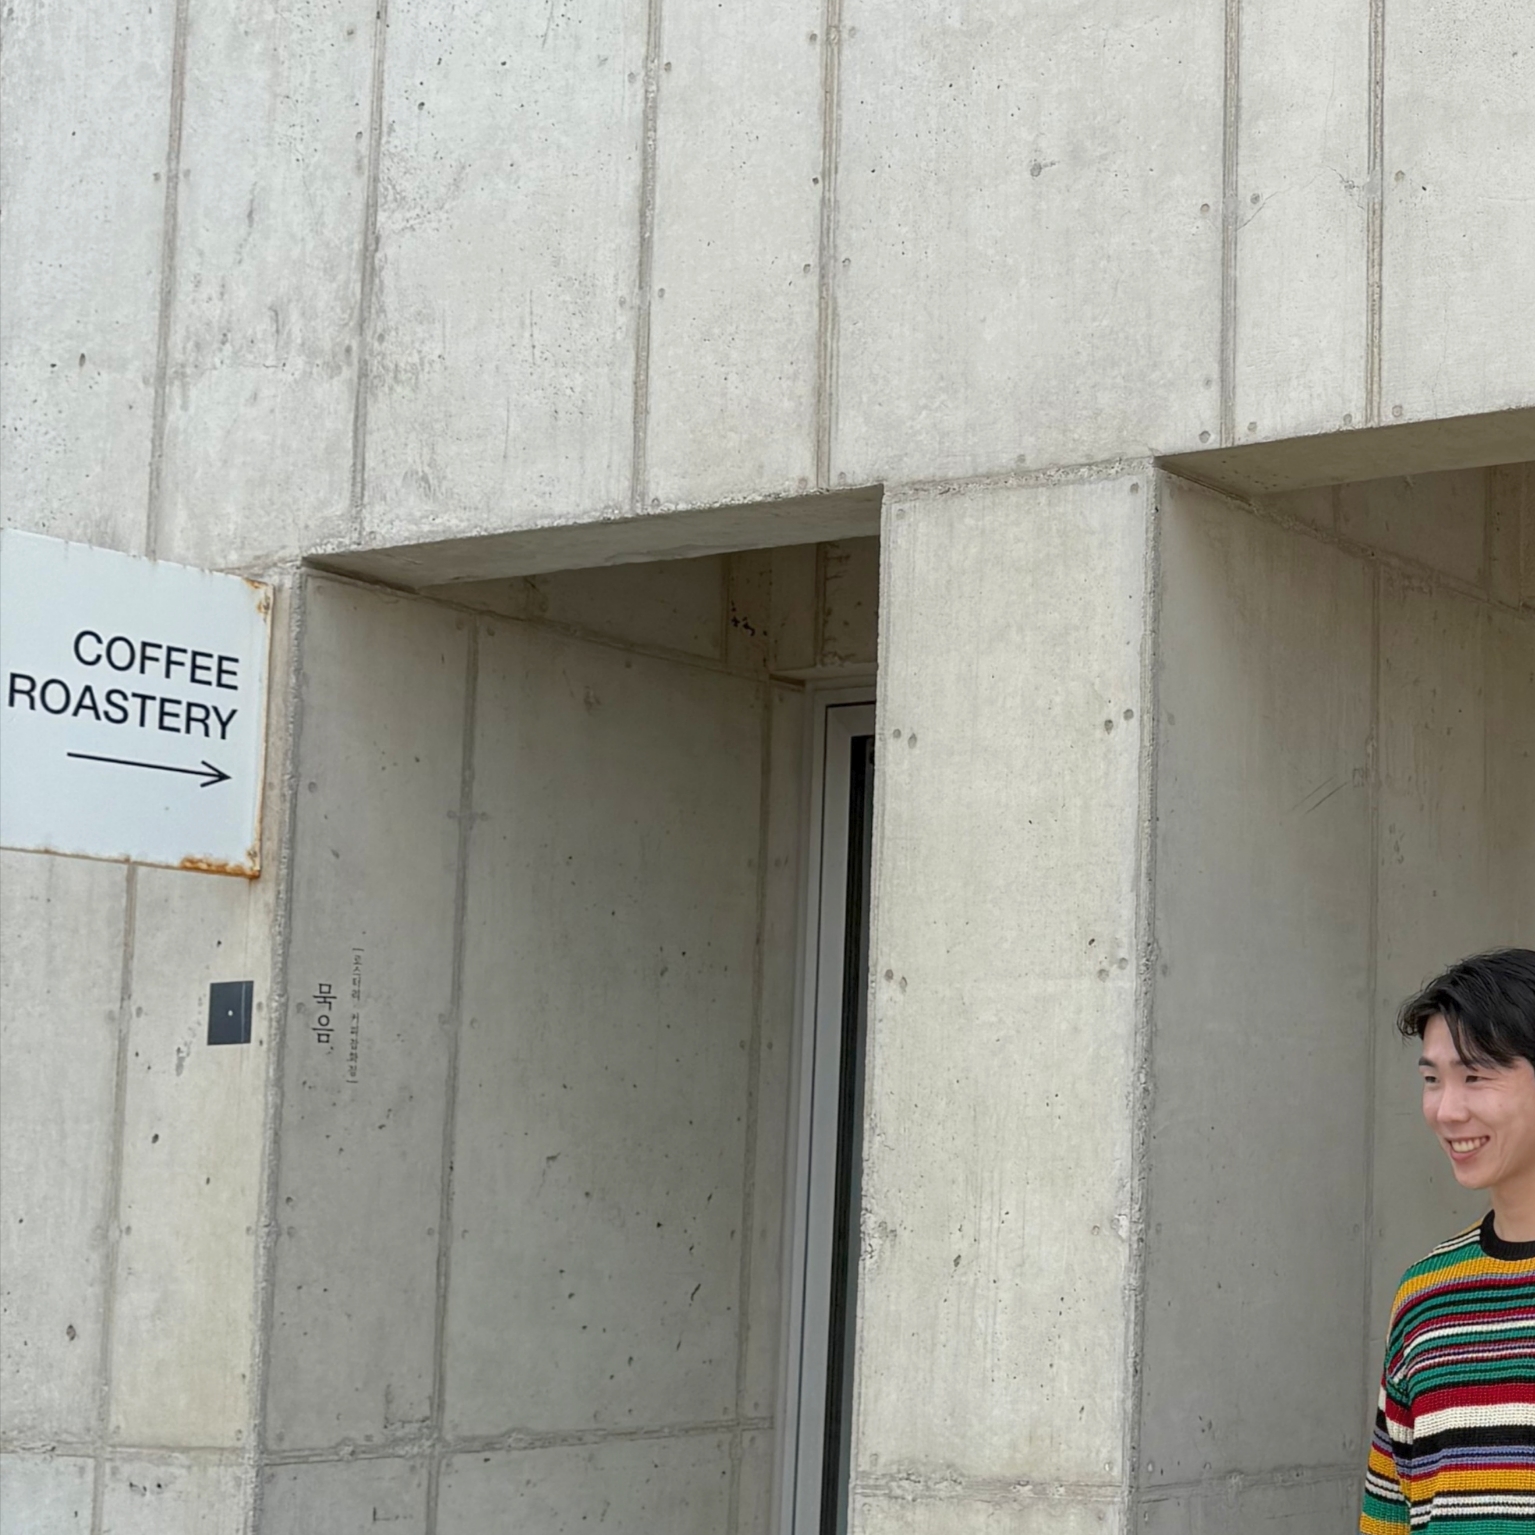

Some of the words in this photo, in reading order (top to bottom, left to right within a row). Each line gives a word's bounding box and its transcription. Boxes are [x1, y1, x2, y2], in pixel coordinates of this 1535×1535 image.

[73, 629, 240, 691] COFFEE
[7, 672, 239, 740] ROASTERY
[312, 983, 338, 1044] 묵음
